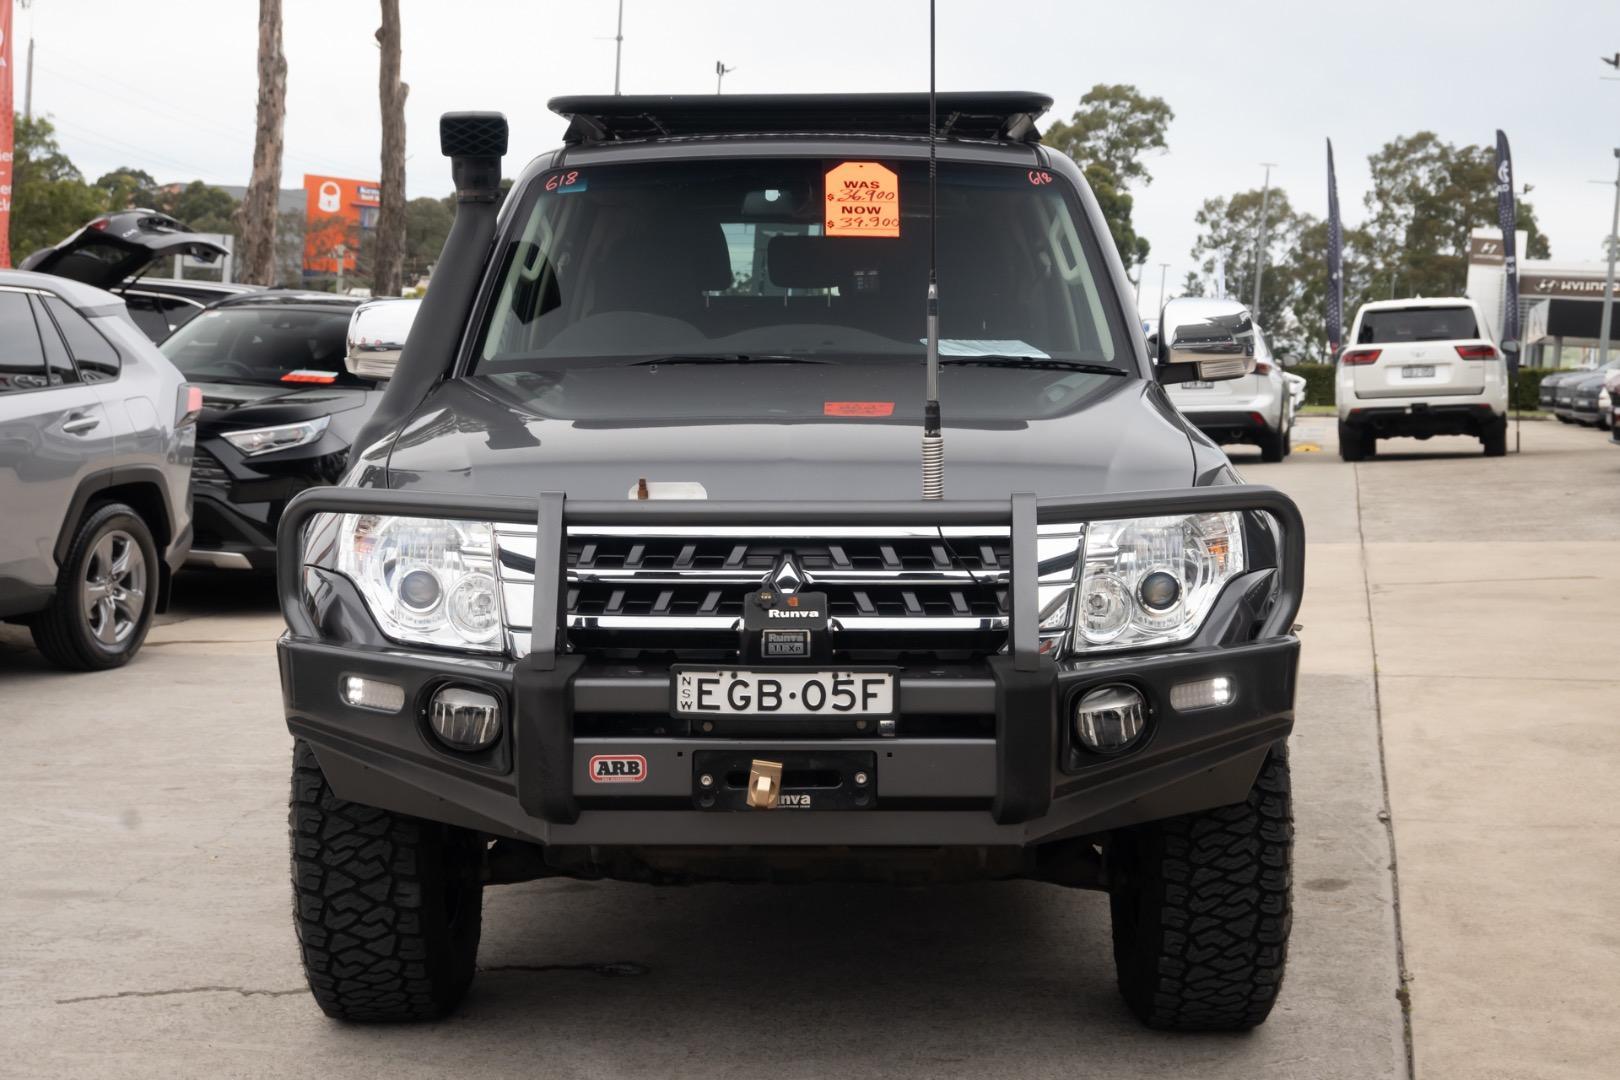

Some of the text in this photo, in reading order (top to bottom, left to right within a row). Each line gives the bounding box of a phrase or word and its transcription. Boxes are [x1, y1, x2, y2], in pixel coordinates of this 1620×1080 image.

[545, 171, 579, 191] 618
[1028, 171, 1053, 185] 618
[843, 181, 880, 189] WAS
[841, 206, 881, 215] NOW
[768, 609, 819, 618] Runva
[596, 760, 641, 776] ARB
[777, 794, 811, 805] nva
